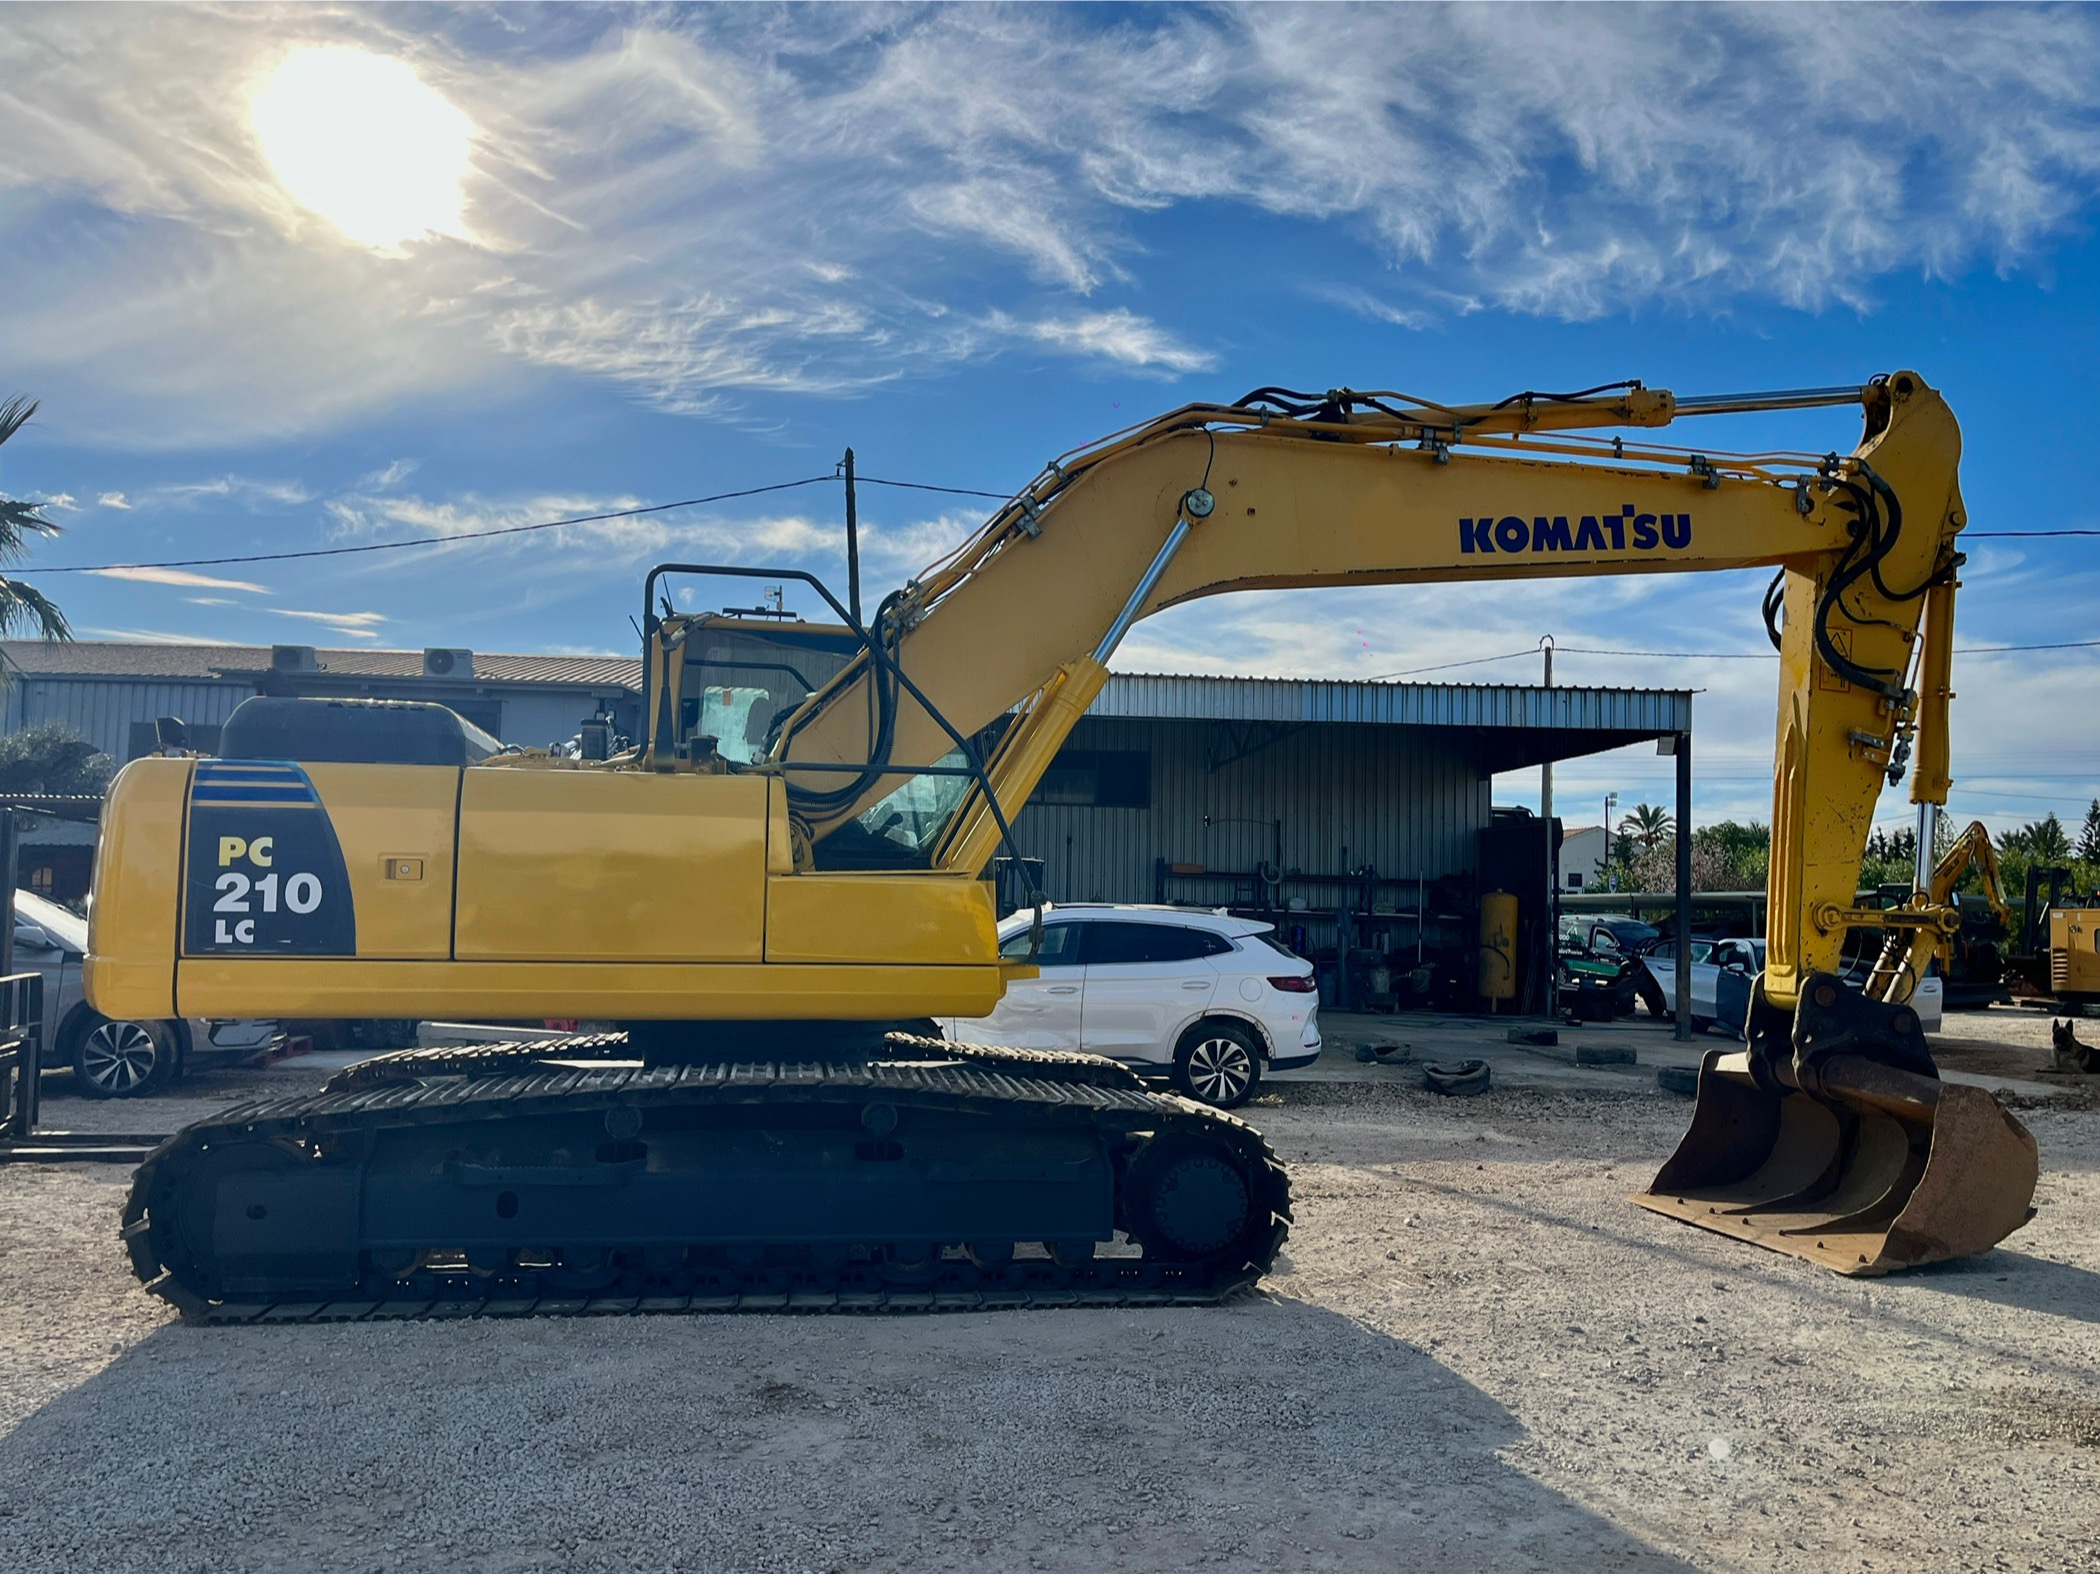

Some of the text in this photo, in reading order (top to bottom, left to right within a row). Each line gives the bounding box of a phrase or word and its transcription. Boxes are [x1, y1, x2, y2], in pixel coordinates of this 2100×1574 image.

[1459, 504, 1692, 553] KOMATSU
[218, 836, 273, 867] PC
[213, 872, 323, 914] 210
[215, 919, 255, 944] LC
